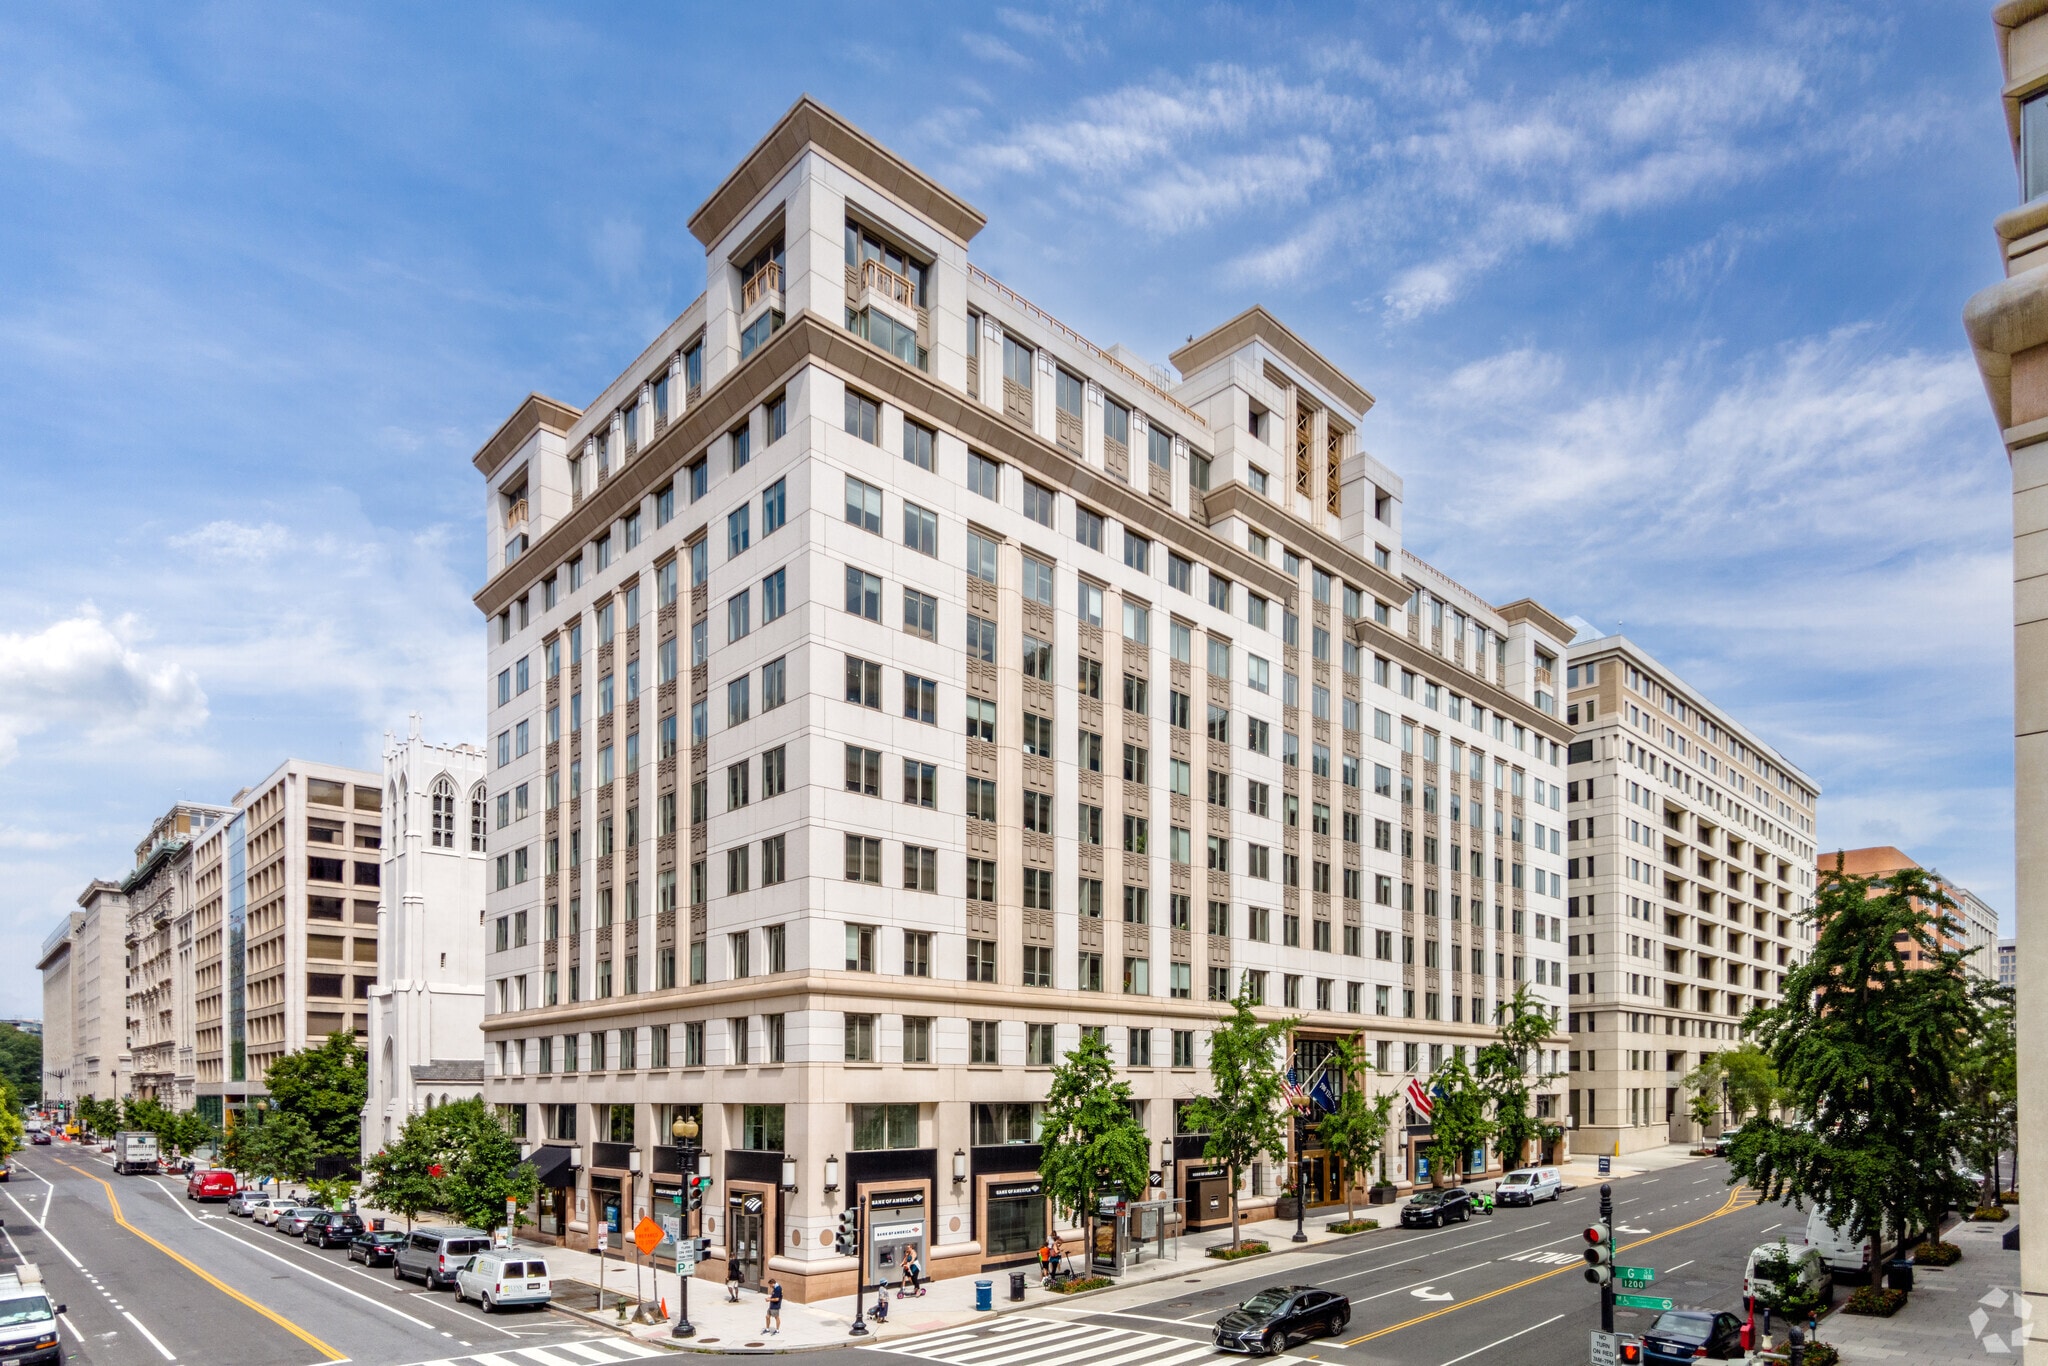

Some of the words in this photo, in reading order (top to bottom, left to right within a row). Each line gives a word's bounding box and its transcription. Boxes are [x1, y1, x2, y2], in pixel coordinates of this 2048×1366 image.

[1511, 1252, 1585, 1264] ONLY
[678, 1263, 686, 1273] P
[1627, 1268, 1635, 1279] G
[1624, 1280, 1644, 1289] 1200
[1596, 1341, 1610, 1349] TURN
